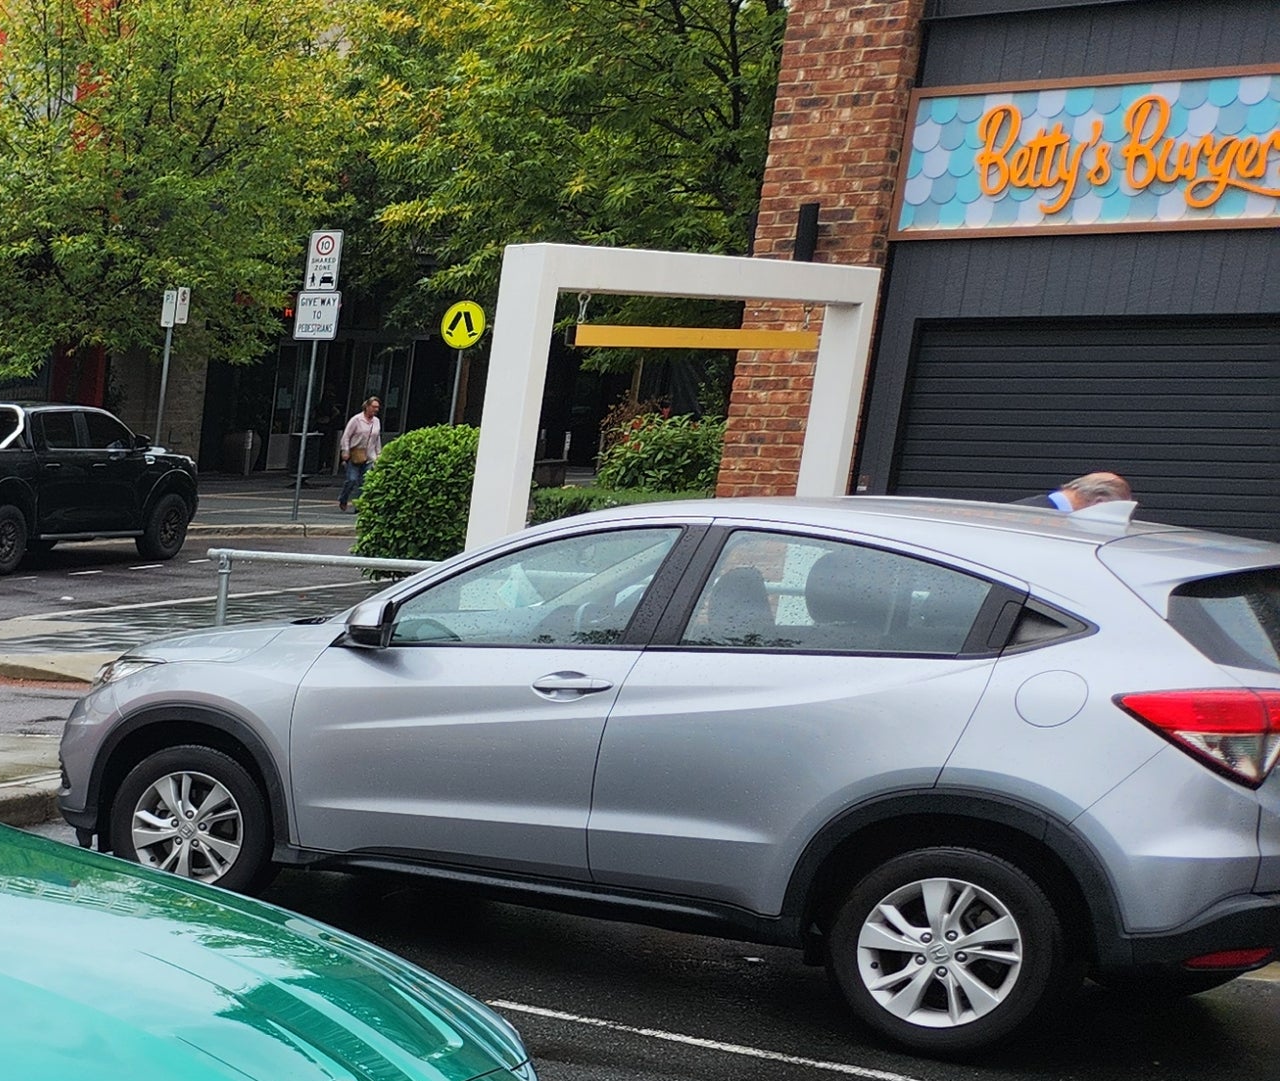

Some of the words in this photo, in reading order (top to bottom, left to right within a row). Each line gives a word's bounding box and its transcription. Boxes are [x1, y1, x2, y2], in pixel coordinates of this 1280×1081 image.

[977, 103, 1112, 214] Betty's
[1122, 93, 1280, 208] Burger
[320, 240, 331, 251] 10
[300, 297, 320, 307] GIVE
[320, 297, 338, 307] WAY
[313, 310, 322, 320] TO
[297, 323, 333, 333] PEDESTRIANS
